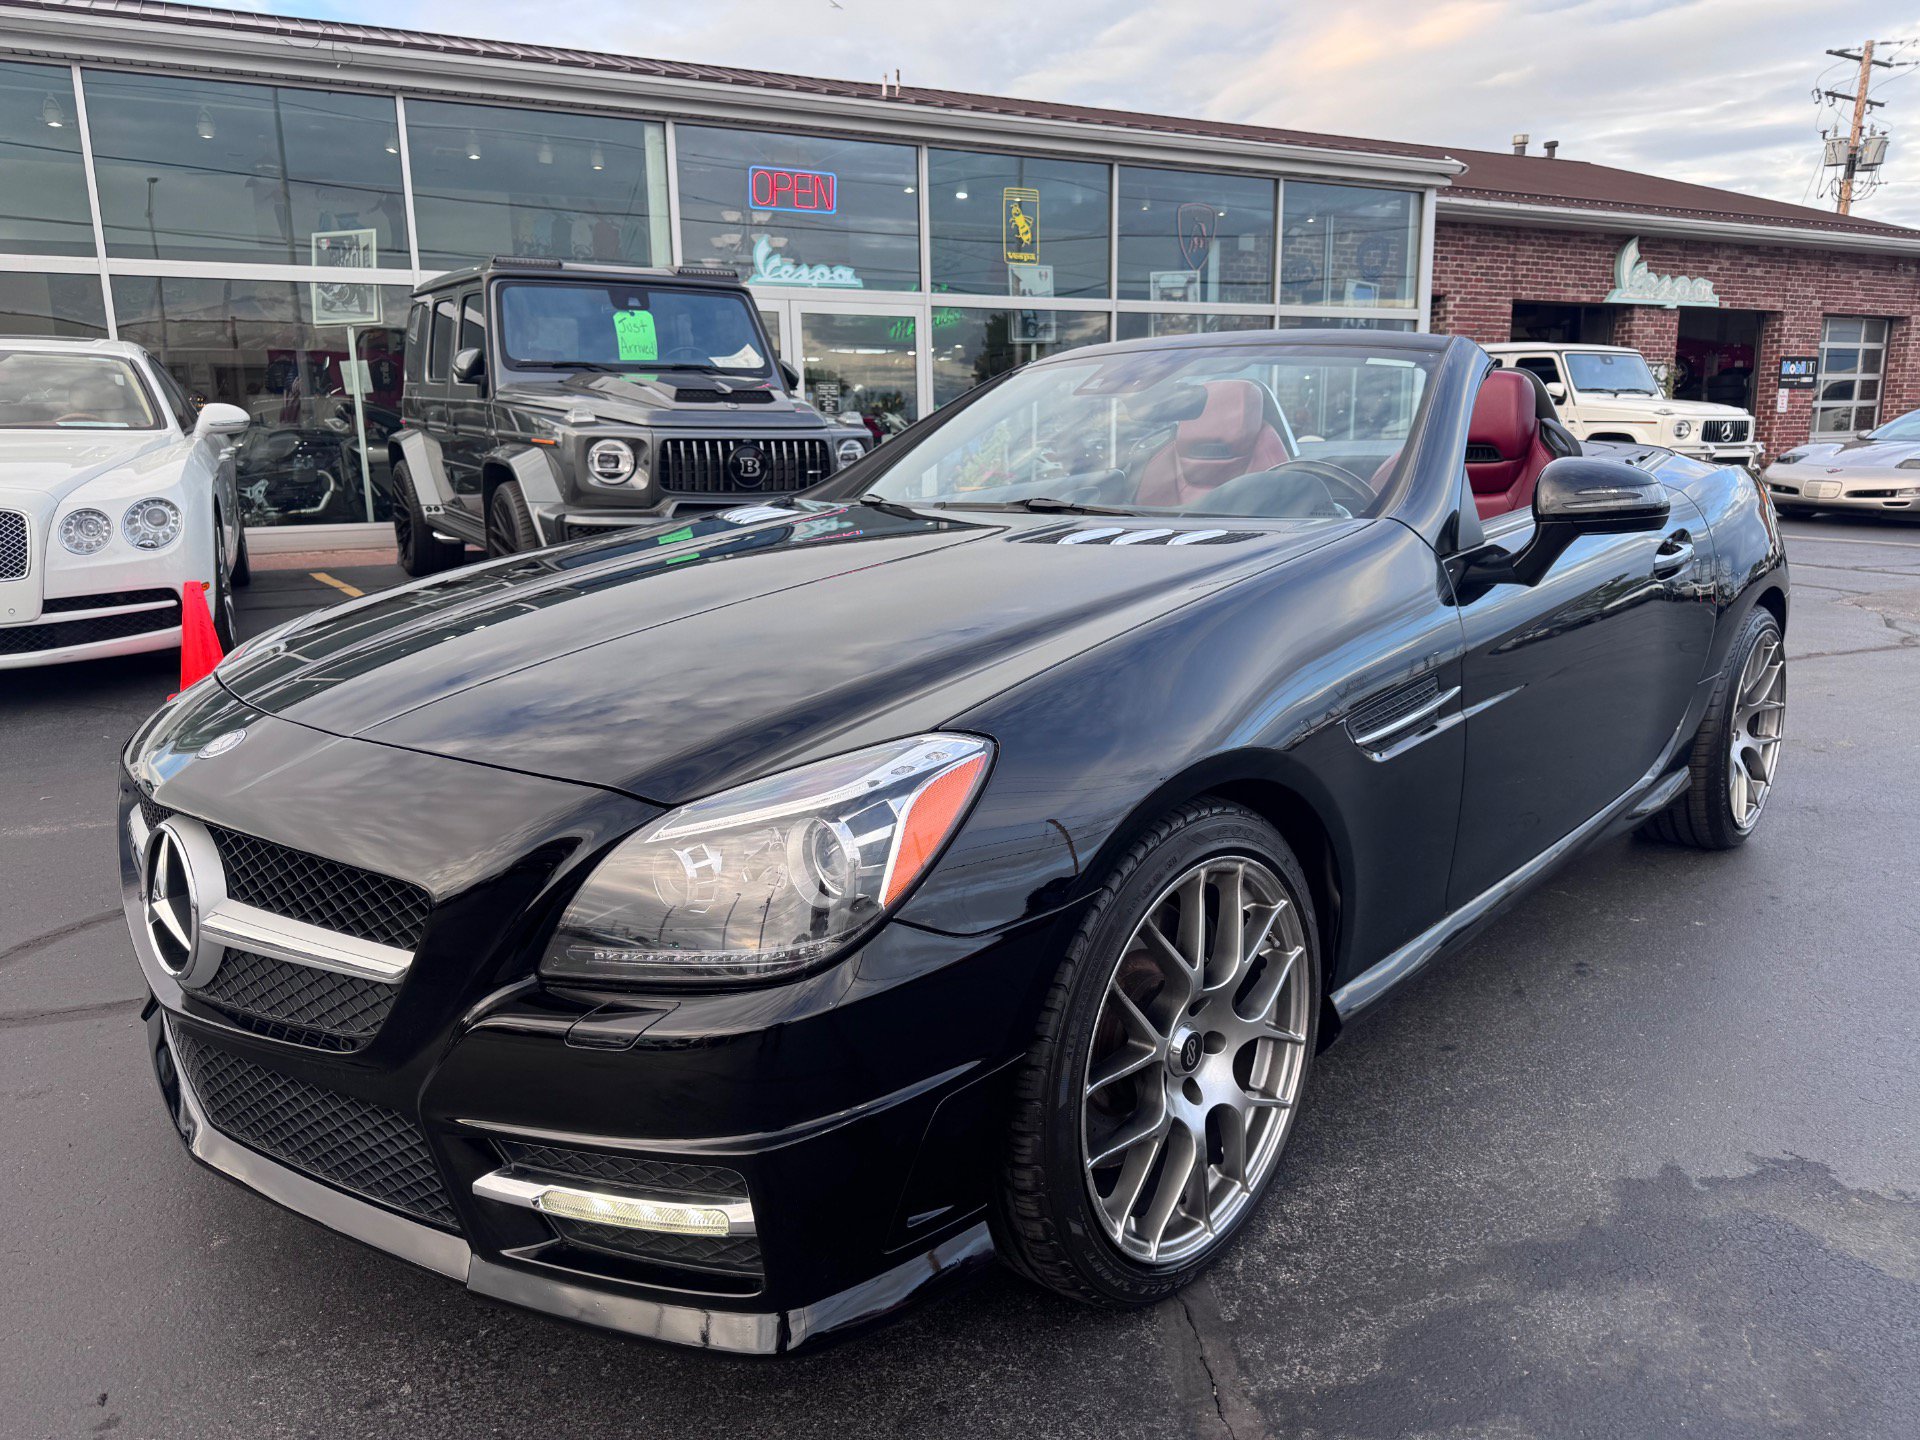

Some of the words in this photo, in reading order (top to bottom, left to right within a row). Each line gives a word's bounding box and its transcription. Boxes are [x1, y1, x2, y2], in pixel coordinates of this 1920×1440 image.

[752, 170, 833, 210] OPEN
[751, 235, 862, 287] Vespa
[1604, 236, 1719, 309] Vespa
[1781, 361, 1807, 375] Mobil
